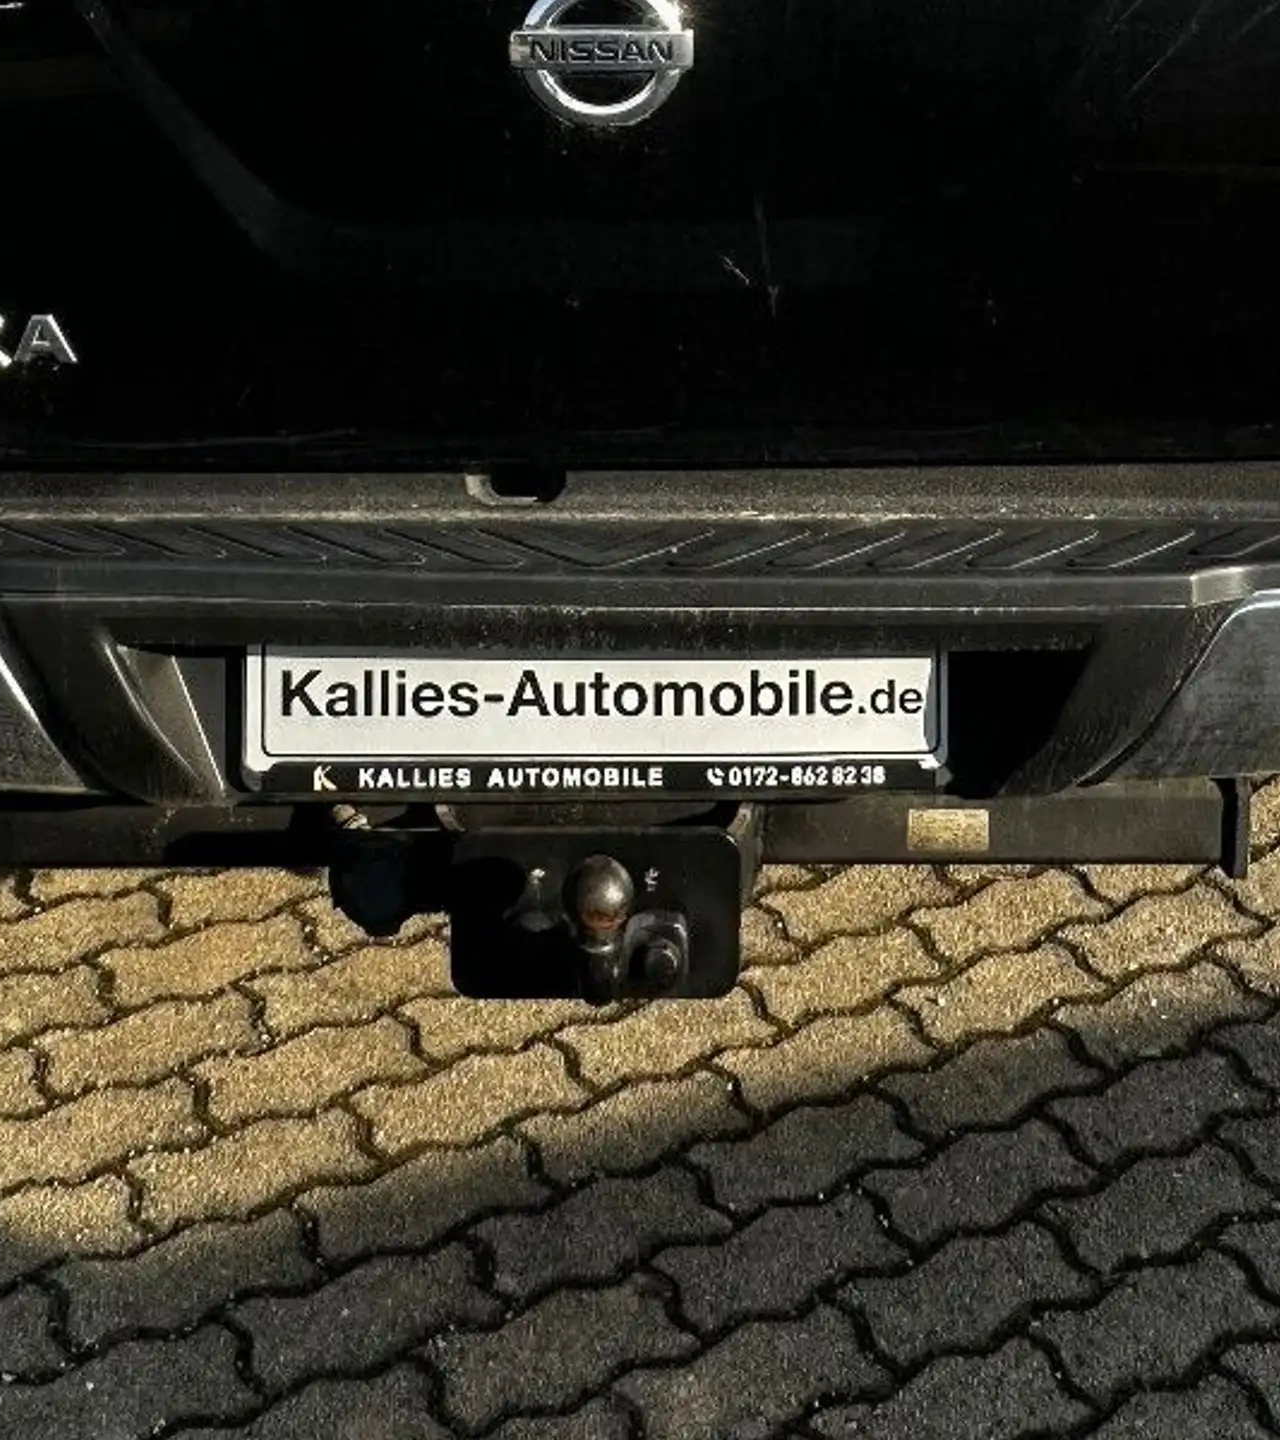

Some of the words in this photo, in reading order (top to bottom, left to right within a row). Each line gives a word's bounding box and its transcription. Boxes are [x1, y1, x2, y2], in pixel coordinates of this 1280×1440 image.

[530, 38, 673, 63] NISSAN
[280, 669, 923, 717] Kallies-Automobile.de
[358, 767, 472, 788] KALLIES
[486, 767, 664, 788] AUTOMOBILE
